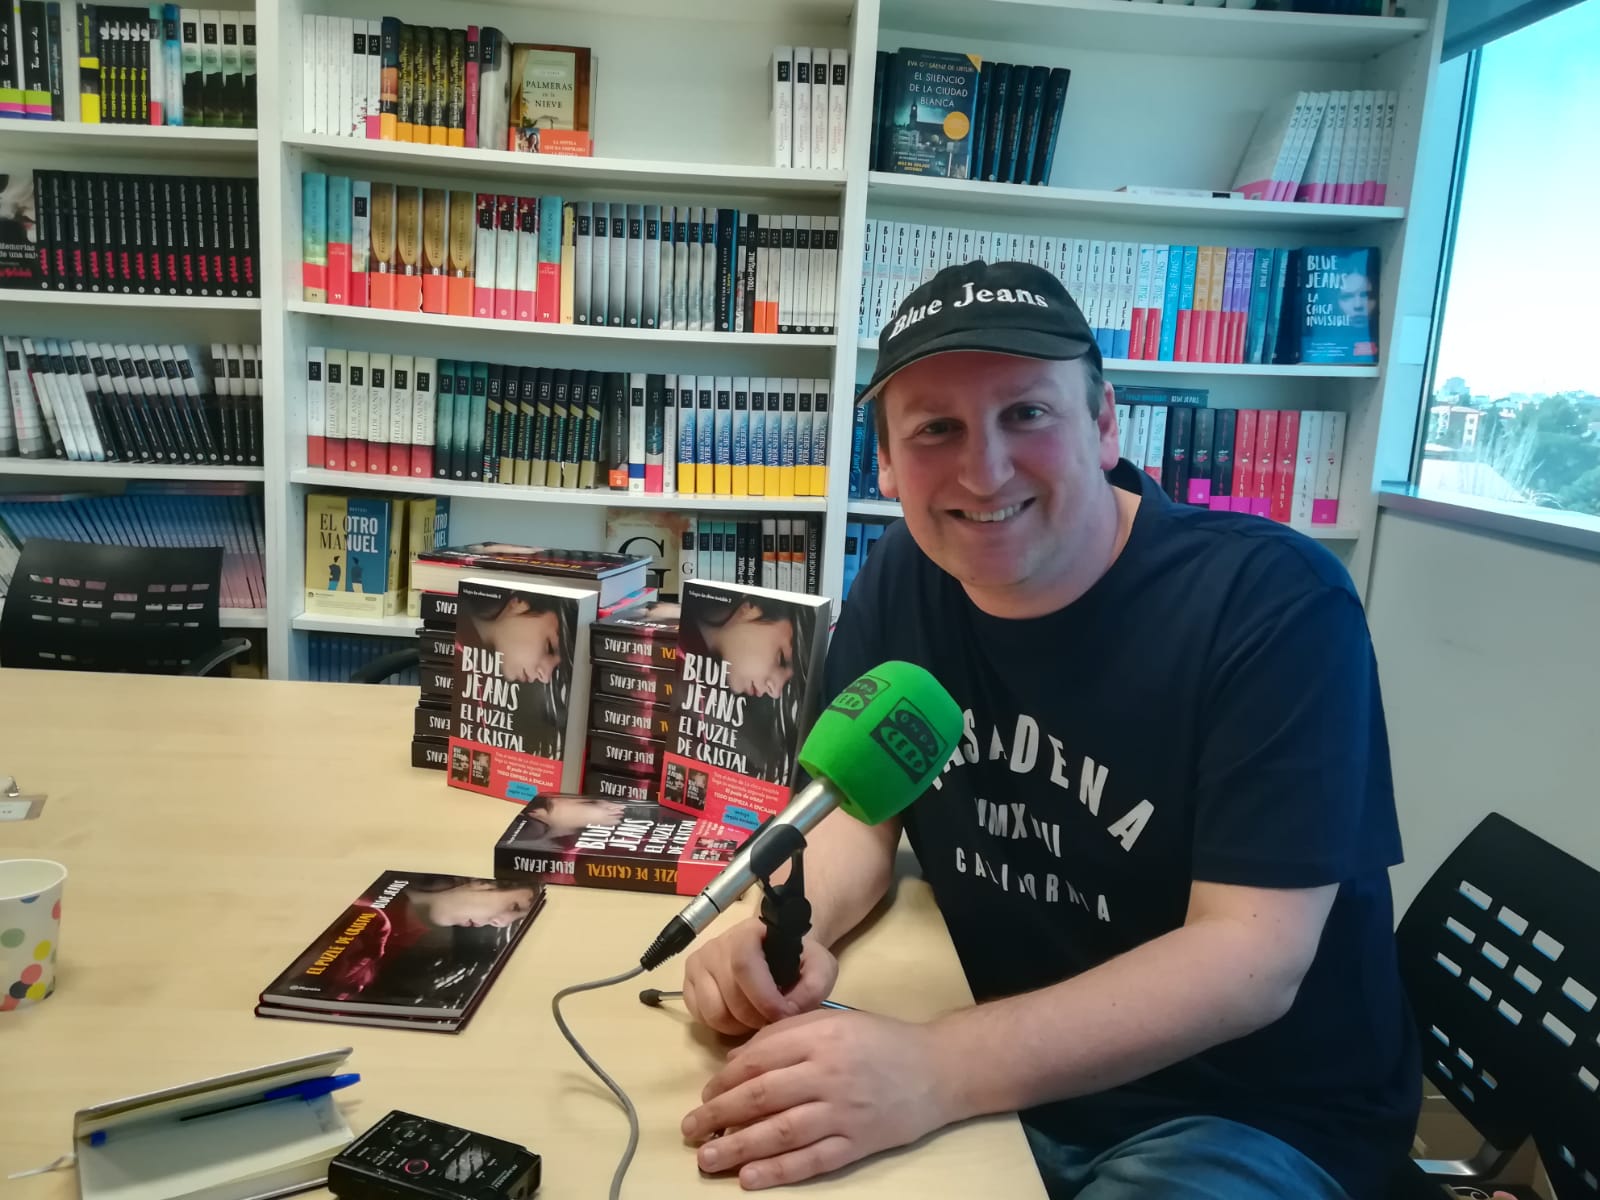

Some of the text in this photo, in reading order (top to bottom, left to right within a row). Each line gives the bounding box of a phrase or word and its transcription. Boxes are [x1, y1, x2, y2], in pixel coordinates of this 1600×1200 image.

[526, 80, 573, 91] PALMERAS
[914, 72, 965, 85] EL SILENCIO
[909, 83, 968, 97] DE LA CIUDAD
[536, 100, 562, 108] NIEVE
[920, 97, 954, 107] BLANCA
[1307, 255, 1338, 271] BLUE
[1306, 272, 1347, 289] JEANS
[1308, 293, 1318, 303] LA
[888, 282, 1048, 341] Blue Jeans
[1306, 304, 1333, 315] CHICA
[1306, 315, 1350, 327] INVISIBLE
[320, 513, 378, 535] EL OTRO
[320, 532, 378, 553] MANUEL
[436, 600, 457, 614] EANS
[434, 642, 455, 656] EANS
[605, 638, 631, 653] JEANS
[632, 643, 652, 656] BLUE
[462, 645, 504, 677] BLUE
[683, 652, 732, 689] BLUE
[462, 673, 520, 711] JEANS
[610, 674, 656, 692] BLUE JEANS
[681, 683, 747, 727] JEANS
[429, 716, 450, 730] EANS
[460, 704, 514, 731] EL PUZLE
[605, 710, 652, 729] BLUE JEANS
[460, 722, 526, 752] DE CRISTAL
[678, 716, 738, 749] EL PUZLE
[426, 750, 448, 763] EANS
[606, 746, 654, 764] BLUE JEANS
[677, 736, 749, 774] DE CRISTAL
[887, 730, 923, 769] CERO
[932, 709, 1154, 852] SADENA
[600, 780, 648, 800] BLUE JEANS
[575, 824, 615, 850] BLUE
[608, 818, 654, 852] JEANS
[644, 823, 676, 854] EL PUZLE
[667, 820, 696, 854] DE CRISTA
[514, 856, 575, 874] BLUE JEANS
[586, 863, 631, 879] CRISTAL
[636, 867, 649, 880] DE
[306, 967, 326, 975] EL
